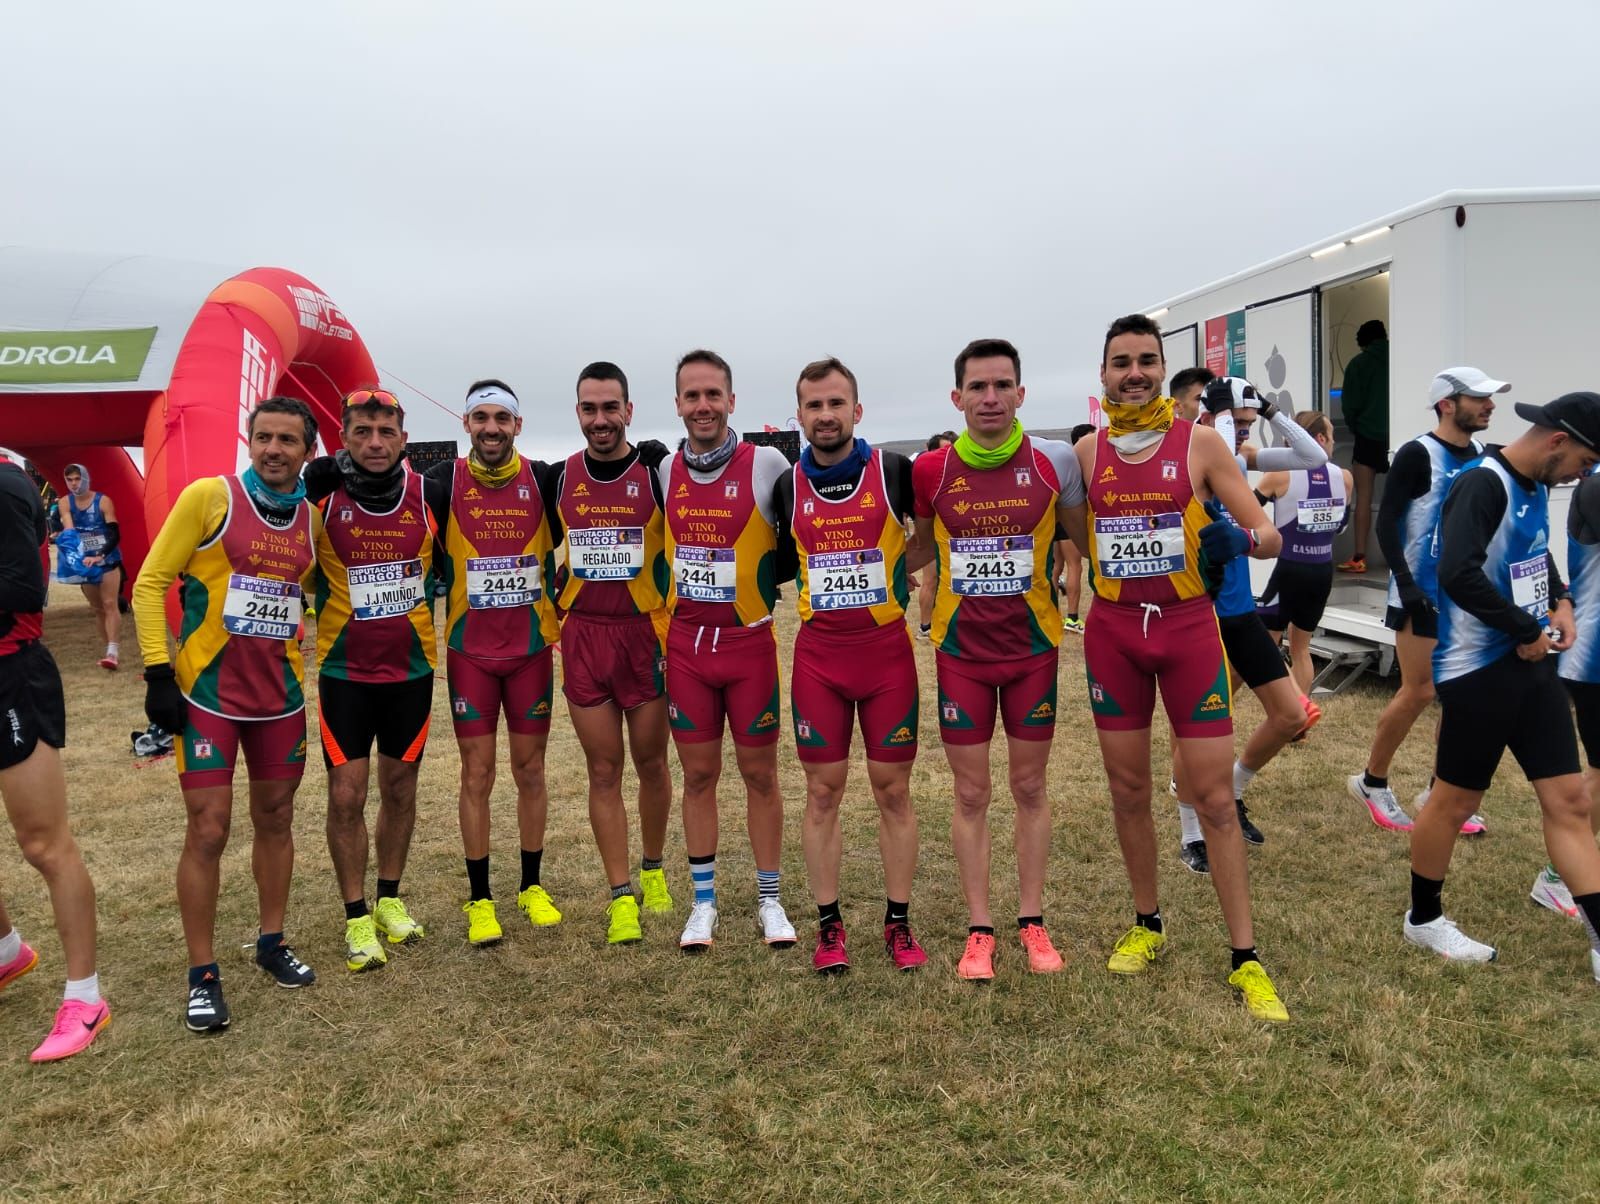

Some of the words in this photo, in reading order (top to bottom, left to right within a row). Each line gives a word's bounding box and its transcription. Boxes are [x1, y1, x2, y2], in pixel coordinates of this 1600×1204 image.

[1142, 493, 1173, 501] RURAL
[973, 502, 996, 510] CAJA
[998, 499, 1030, 508] RURAL
[708, 510, 732, 518] RURAL
[1120, 508, 1153, 516] VINO
[1313, 512, 1332, 522] 835
[485, 521, 515, 529] VINO
[972, 514, 1009, 526] VINO
[688, 522, 716, 532] VINO
[961, 529, 978, 538] DE
[981, 525, 1021, 536] TORO
[262, 531, 289, 546] VINO
[493, 530, 524, 539] TORO
[571, 536, 618, 545] BURGOS
[680, 533, 693, 542] DE
[695, 533, 726, 544] TORO
[824, 530, 853, 540] VINO
[251, 541, 267, 551] DE
[269, 544, 297, 558] TORO
[362, 542, 393, 551] VINO
[816, 542, 830, 551] DE
[832, 539, 864, 549] TORO
[1111, 540, 1163, 560] 2440
[370, 552, 404, 560] TORO
[583, 552, 631, 565] REGALADO
[350, 564, 403, 576] DIPUTACIÓN
[966, 561, 1016, 578] 2443
[241, 577, 282, 589] DIPUTACIÓN
[350, 571, 403, 584] BURGOS
[682, 568, 716, 586] 2441
[824, 574, 869, 592] 2445
[484, 577, 527, 592] 2442
[364, 587, 417, 606] J.J.MUÑOZ
[245, 602, 289, 621] 2444
